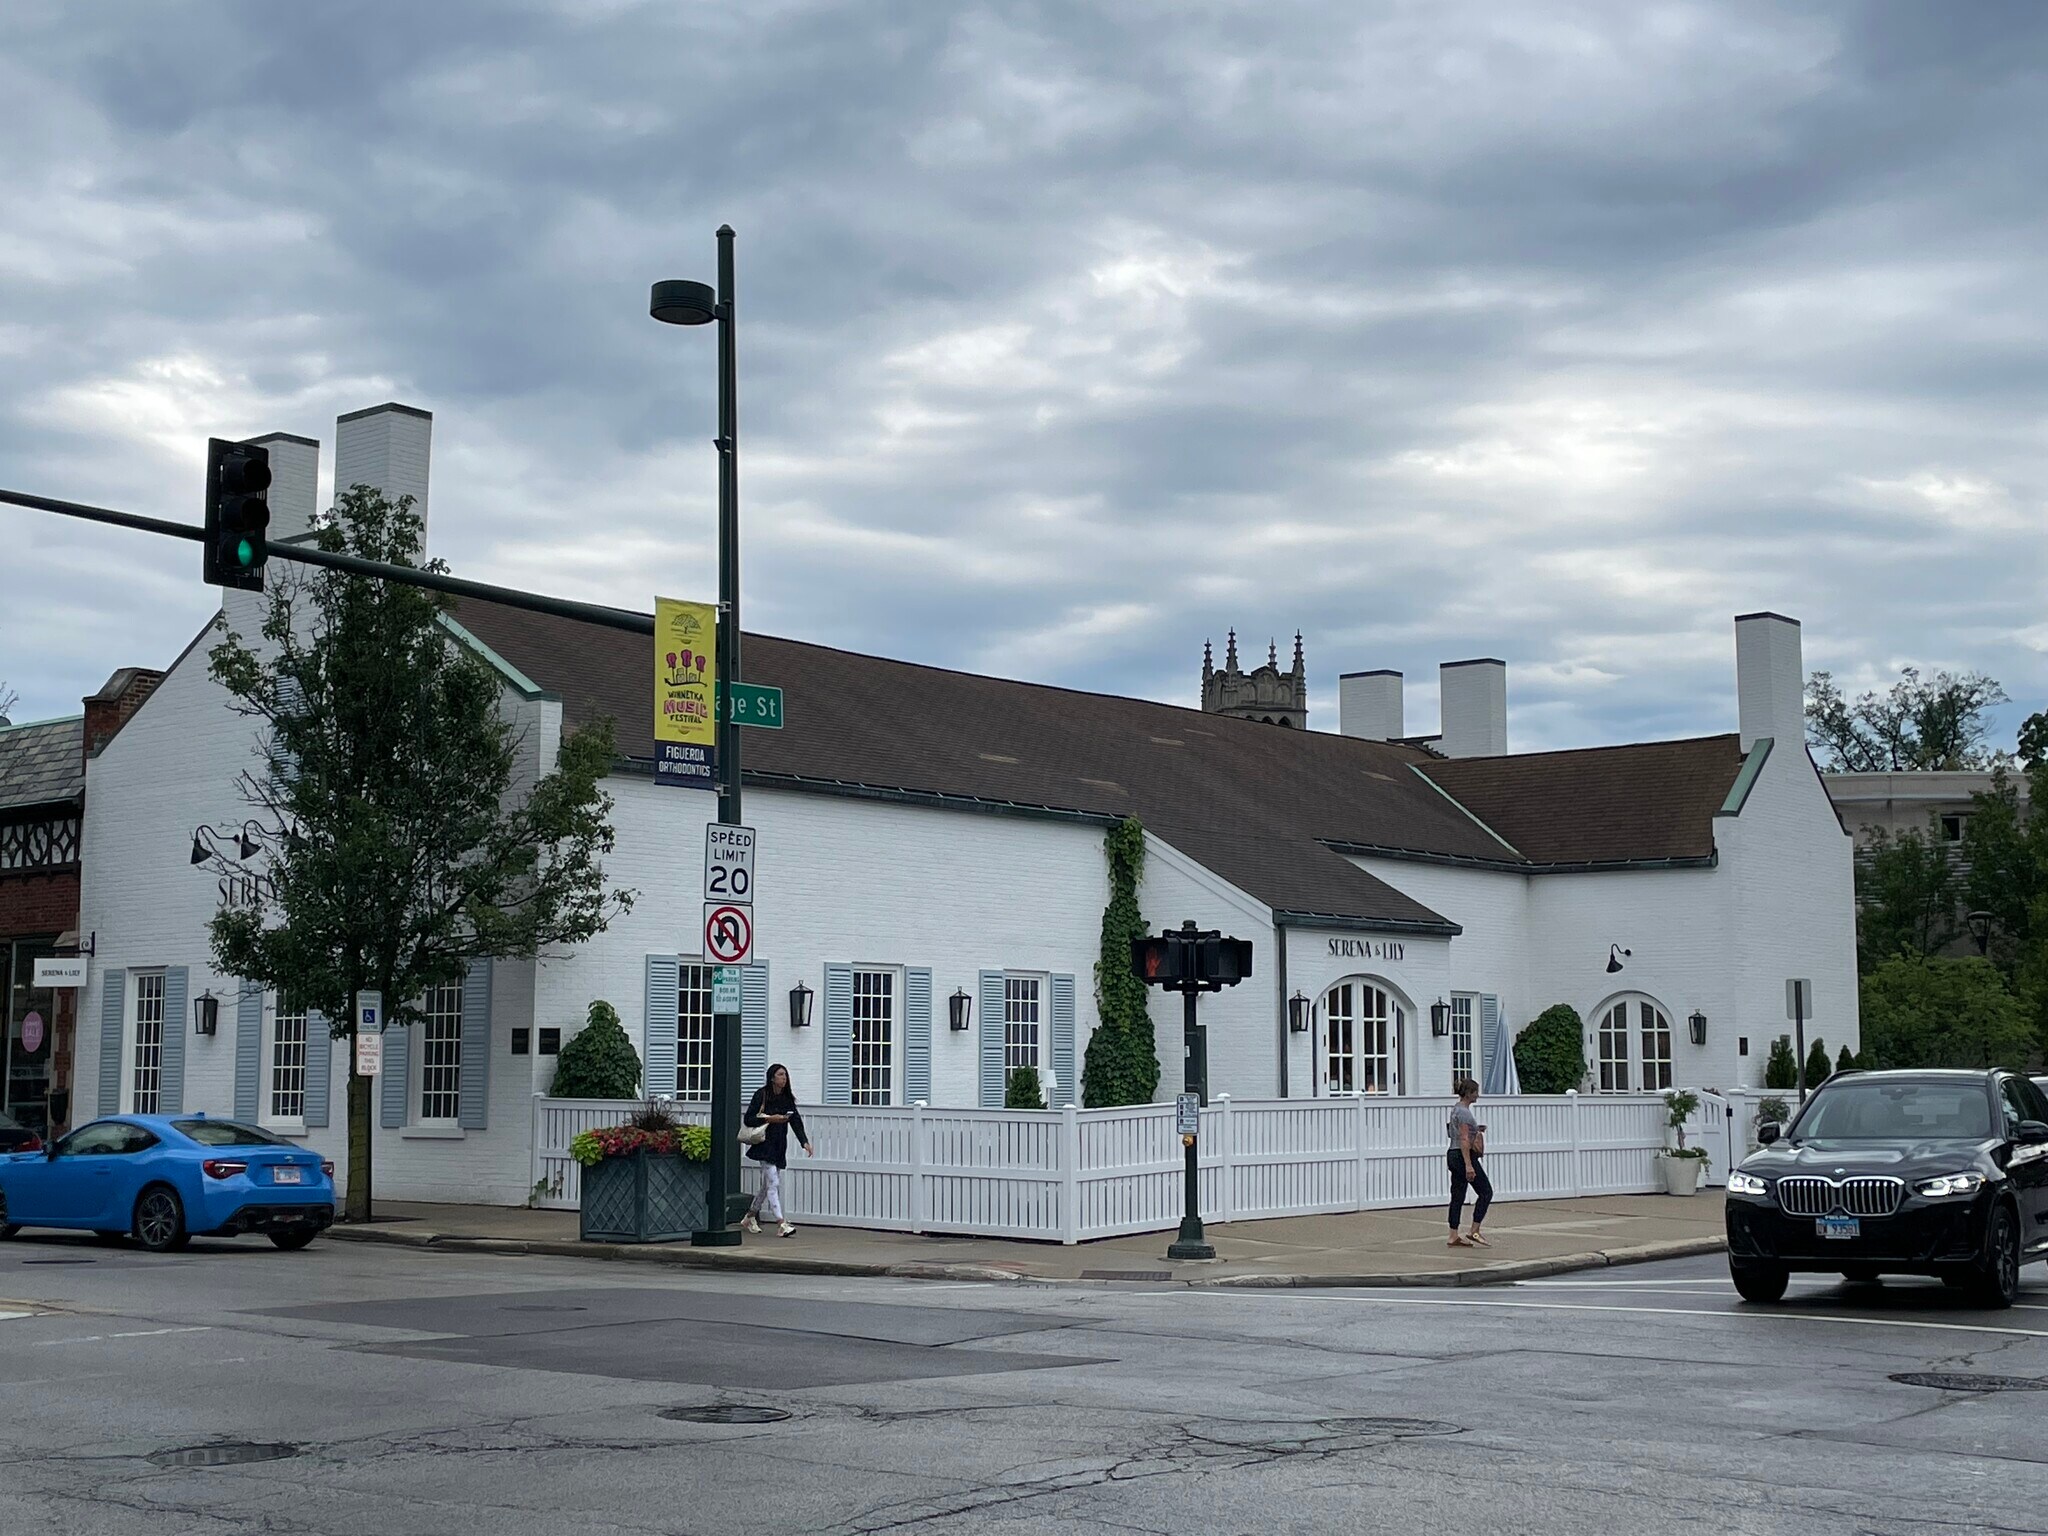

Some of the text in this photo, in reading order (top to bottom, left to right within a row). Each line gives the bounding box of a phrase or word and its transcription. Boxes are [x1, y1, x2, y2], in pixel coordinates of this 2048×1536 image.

[667, 690, 704, 702] WINNETKA
[663, 699, 708, 719] MUSIC
[756, 696, 776, 718] St
[670, 714, 702, 724] FESTIVAL
[665, 745, 705, 762] FIGUEROA
[658, 760, 711, 777] ORTHODONTICS
[710, 831, 752, 847] SPEED
[714, 848, 746, 862] LIMIT
[709, 865, 749, 895] 20
[1328, 938, 1406, 961] SERENA & LILY
[41, 969, 63, 977] SERENA
